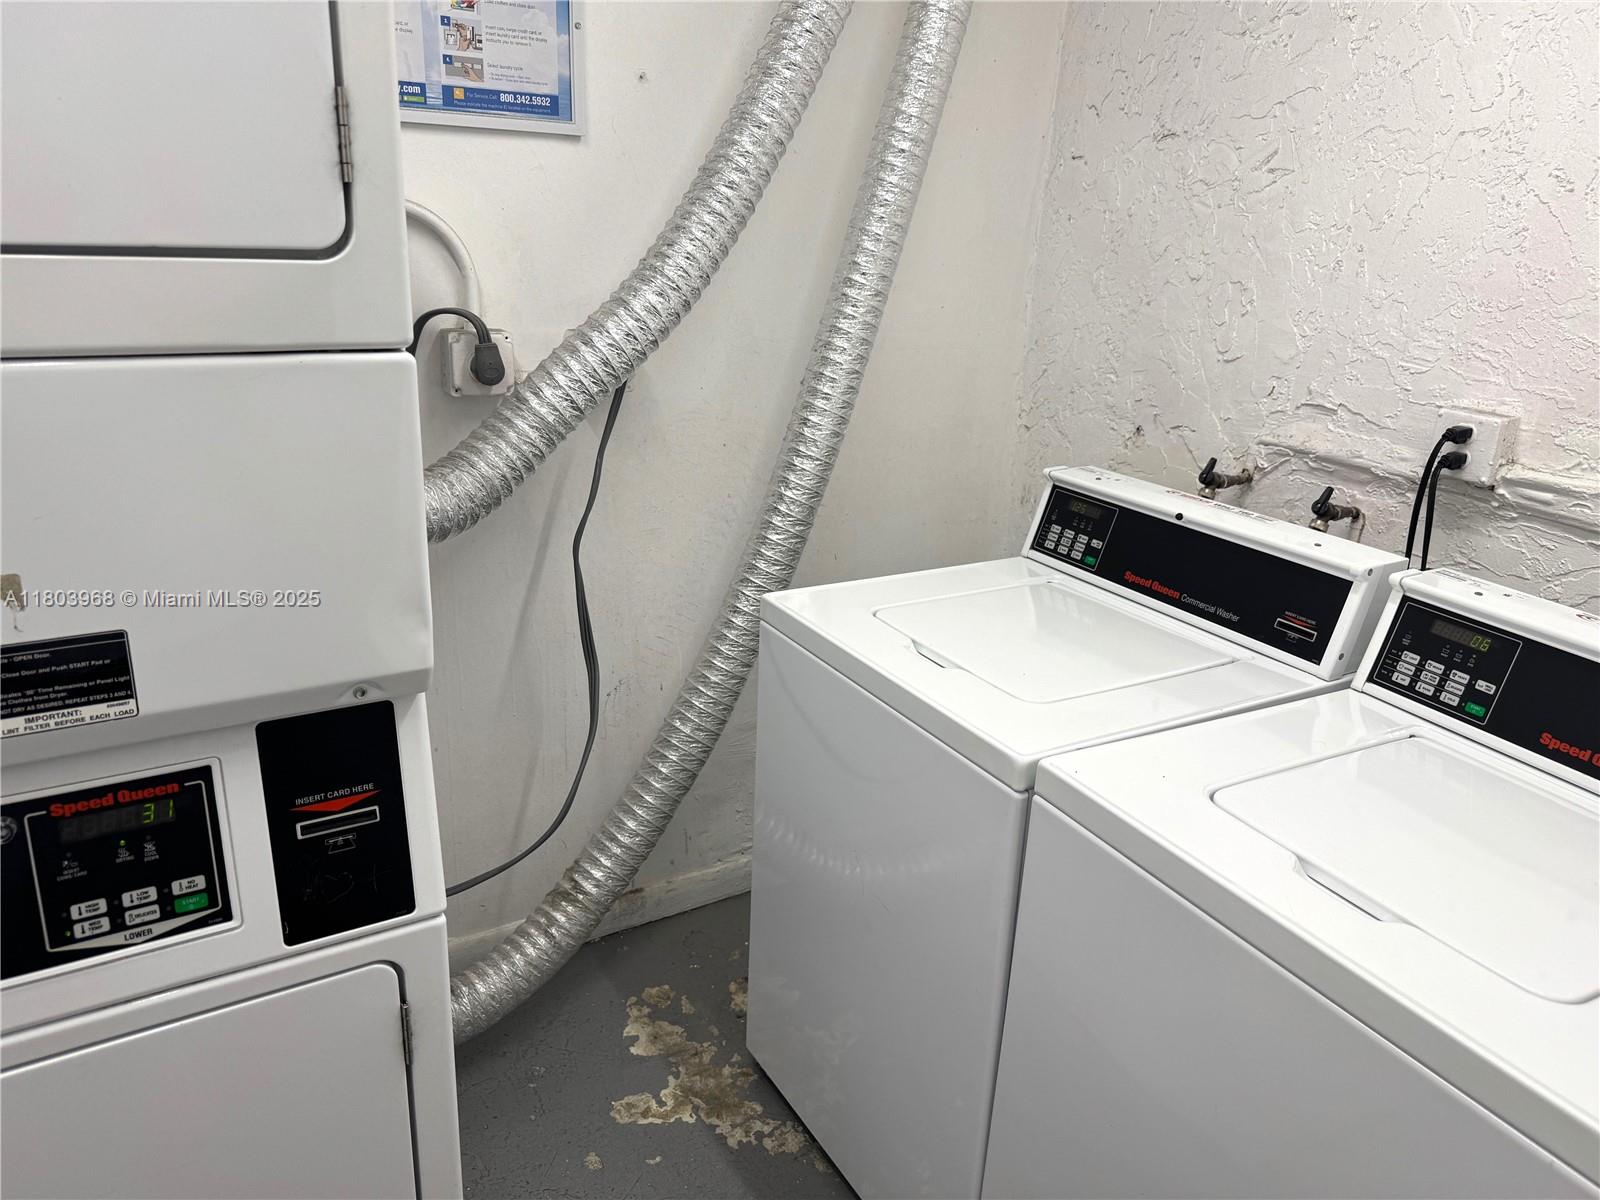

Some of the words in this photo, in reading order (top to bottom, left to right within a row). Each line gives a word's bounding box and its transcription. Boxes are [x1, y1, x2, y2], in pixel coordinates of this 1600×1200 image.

[499, 92, 551, 106] 800.342.5932
[1124, 570, 1151, 588] Speed
[1151, 580, 1181, 599] Queen
[1181, 593, 1216, 613] Commercial
[1216, 607, 1240, 623] Washer
[2, 727, 20, 736] LINT
[24, 722, 51, 732] FILTER
[54, 716, 87, 727] BEFORE
[89, 712, 111, 721] EACH
[114, 708, 135, 717] LOAD
[24, 709, 82, 725] IMPORTANT:
[1539, 731, 1592, 763] Speed
[50, 793, 114, 817] Speed
[117, 782, 180, 803] Queen
[295, 793, 325, 806] INSERT
[327, 788, 351, 799] CARD
[352, 782, 375, 793] HERE
[124, 927, 153, 941] LOWER
